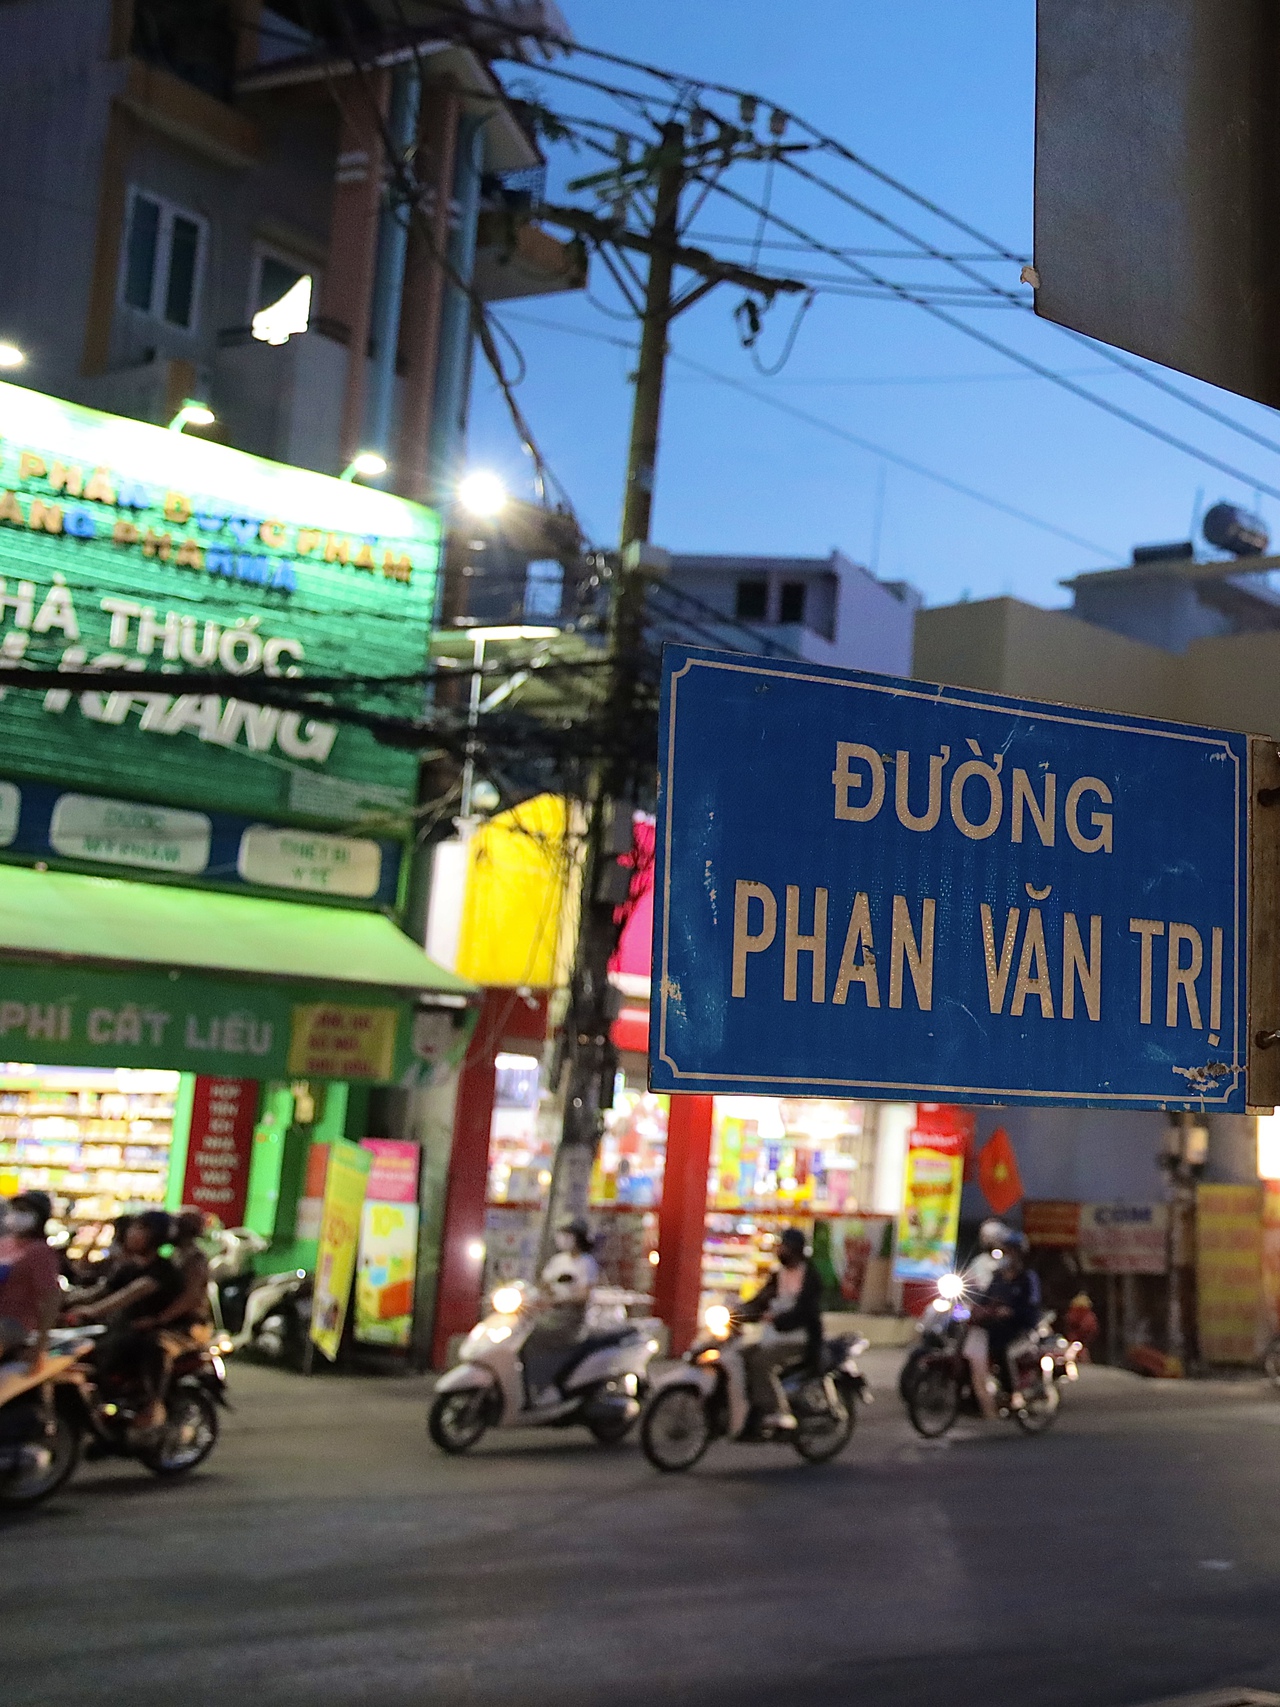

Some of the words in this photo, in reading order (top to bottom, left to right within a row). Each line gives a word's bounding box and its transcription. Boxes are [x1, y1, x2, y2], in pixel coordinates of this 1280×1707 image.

[100, 597, 305, 678] THUỐC
[832, 738, 1115, 854] ĐƯỜNG
[731, 878, 937, 1012] PHAN
[980, 883, 1102, 1022] VĂN
[1129, 917, 1224, 1047] TRỊ
